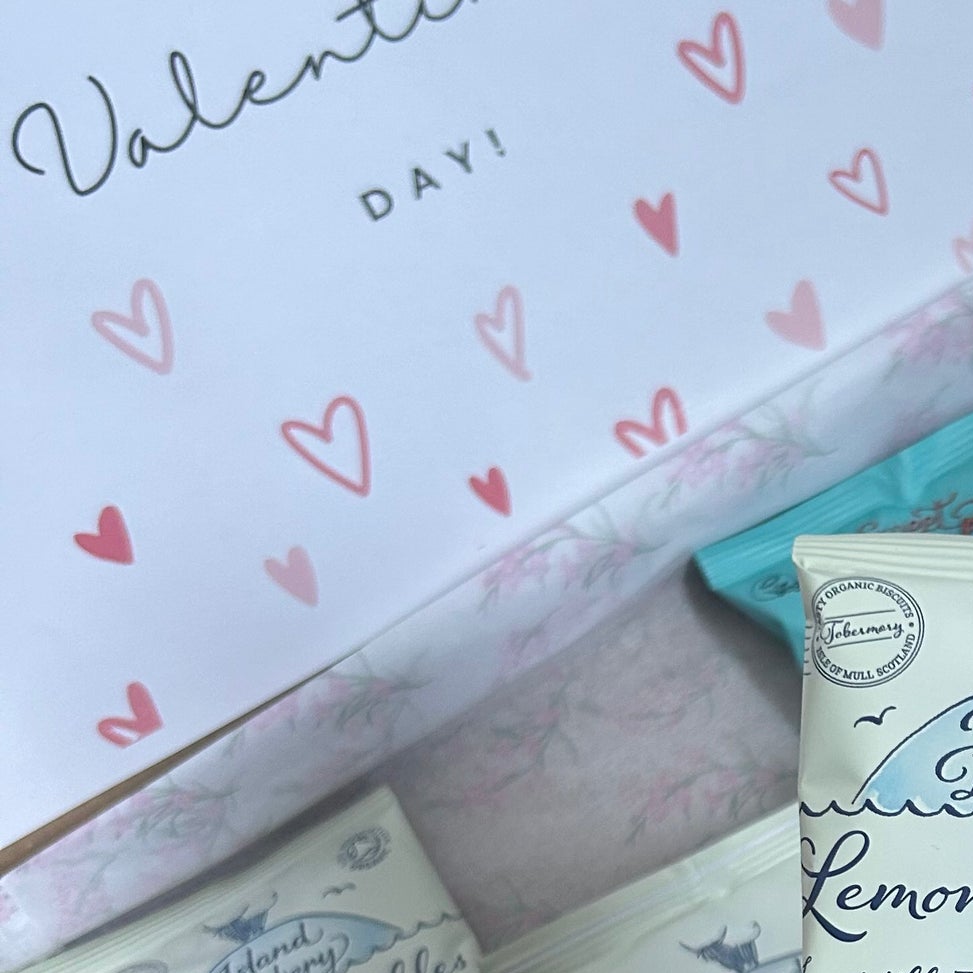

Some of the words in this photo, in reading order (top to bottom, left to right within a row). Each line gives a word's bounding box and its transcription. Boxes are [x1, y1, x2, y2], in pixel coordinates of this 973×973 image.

[357, 128, 508, 222] DAY!
[824, 581, 876, 600] ORGANIC
[875, 582, 915, 620] BISCUITS
[820, 619, 905, 645] Tobermory
[829, 664, 844, 677] OF
[842, 669, 875, 681] MULL
[875, 633, 916, 677] SCOTLAND
